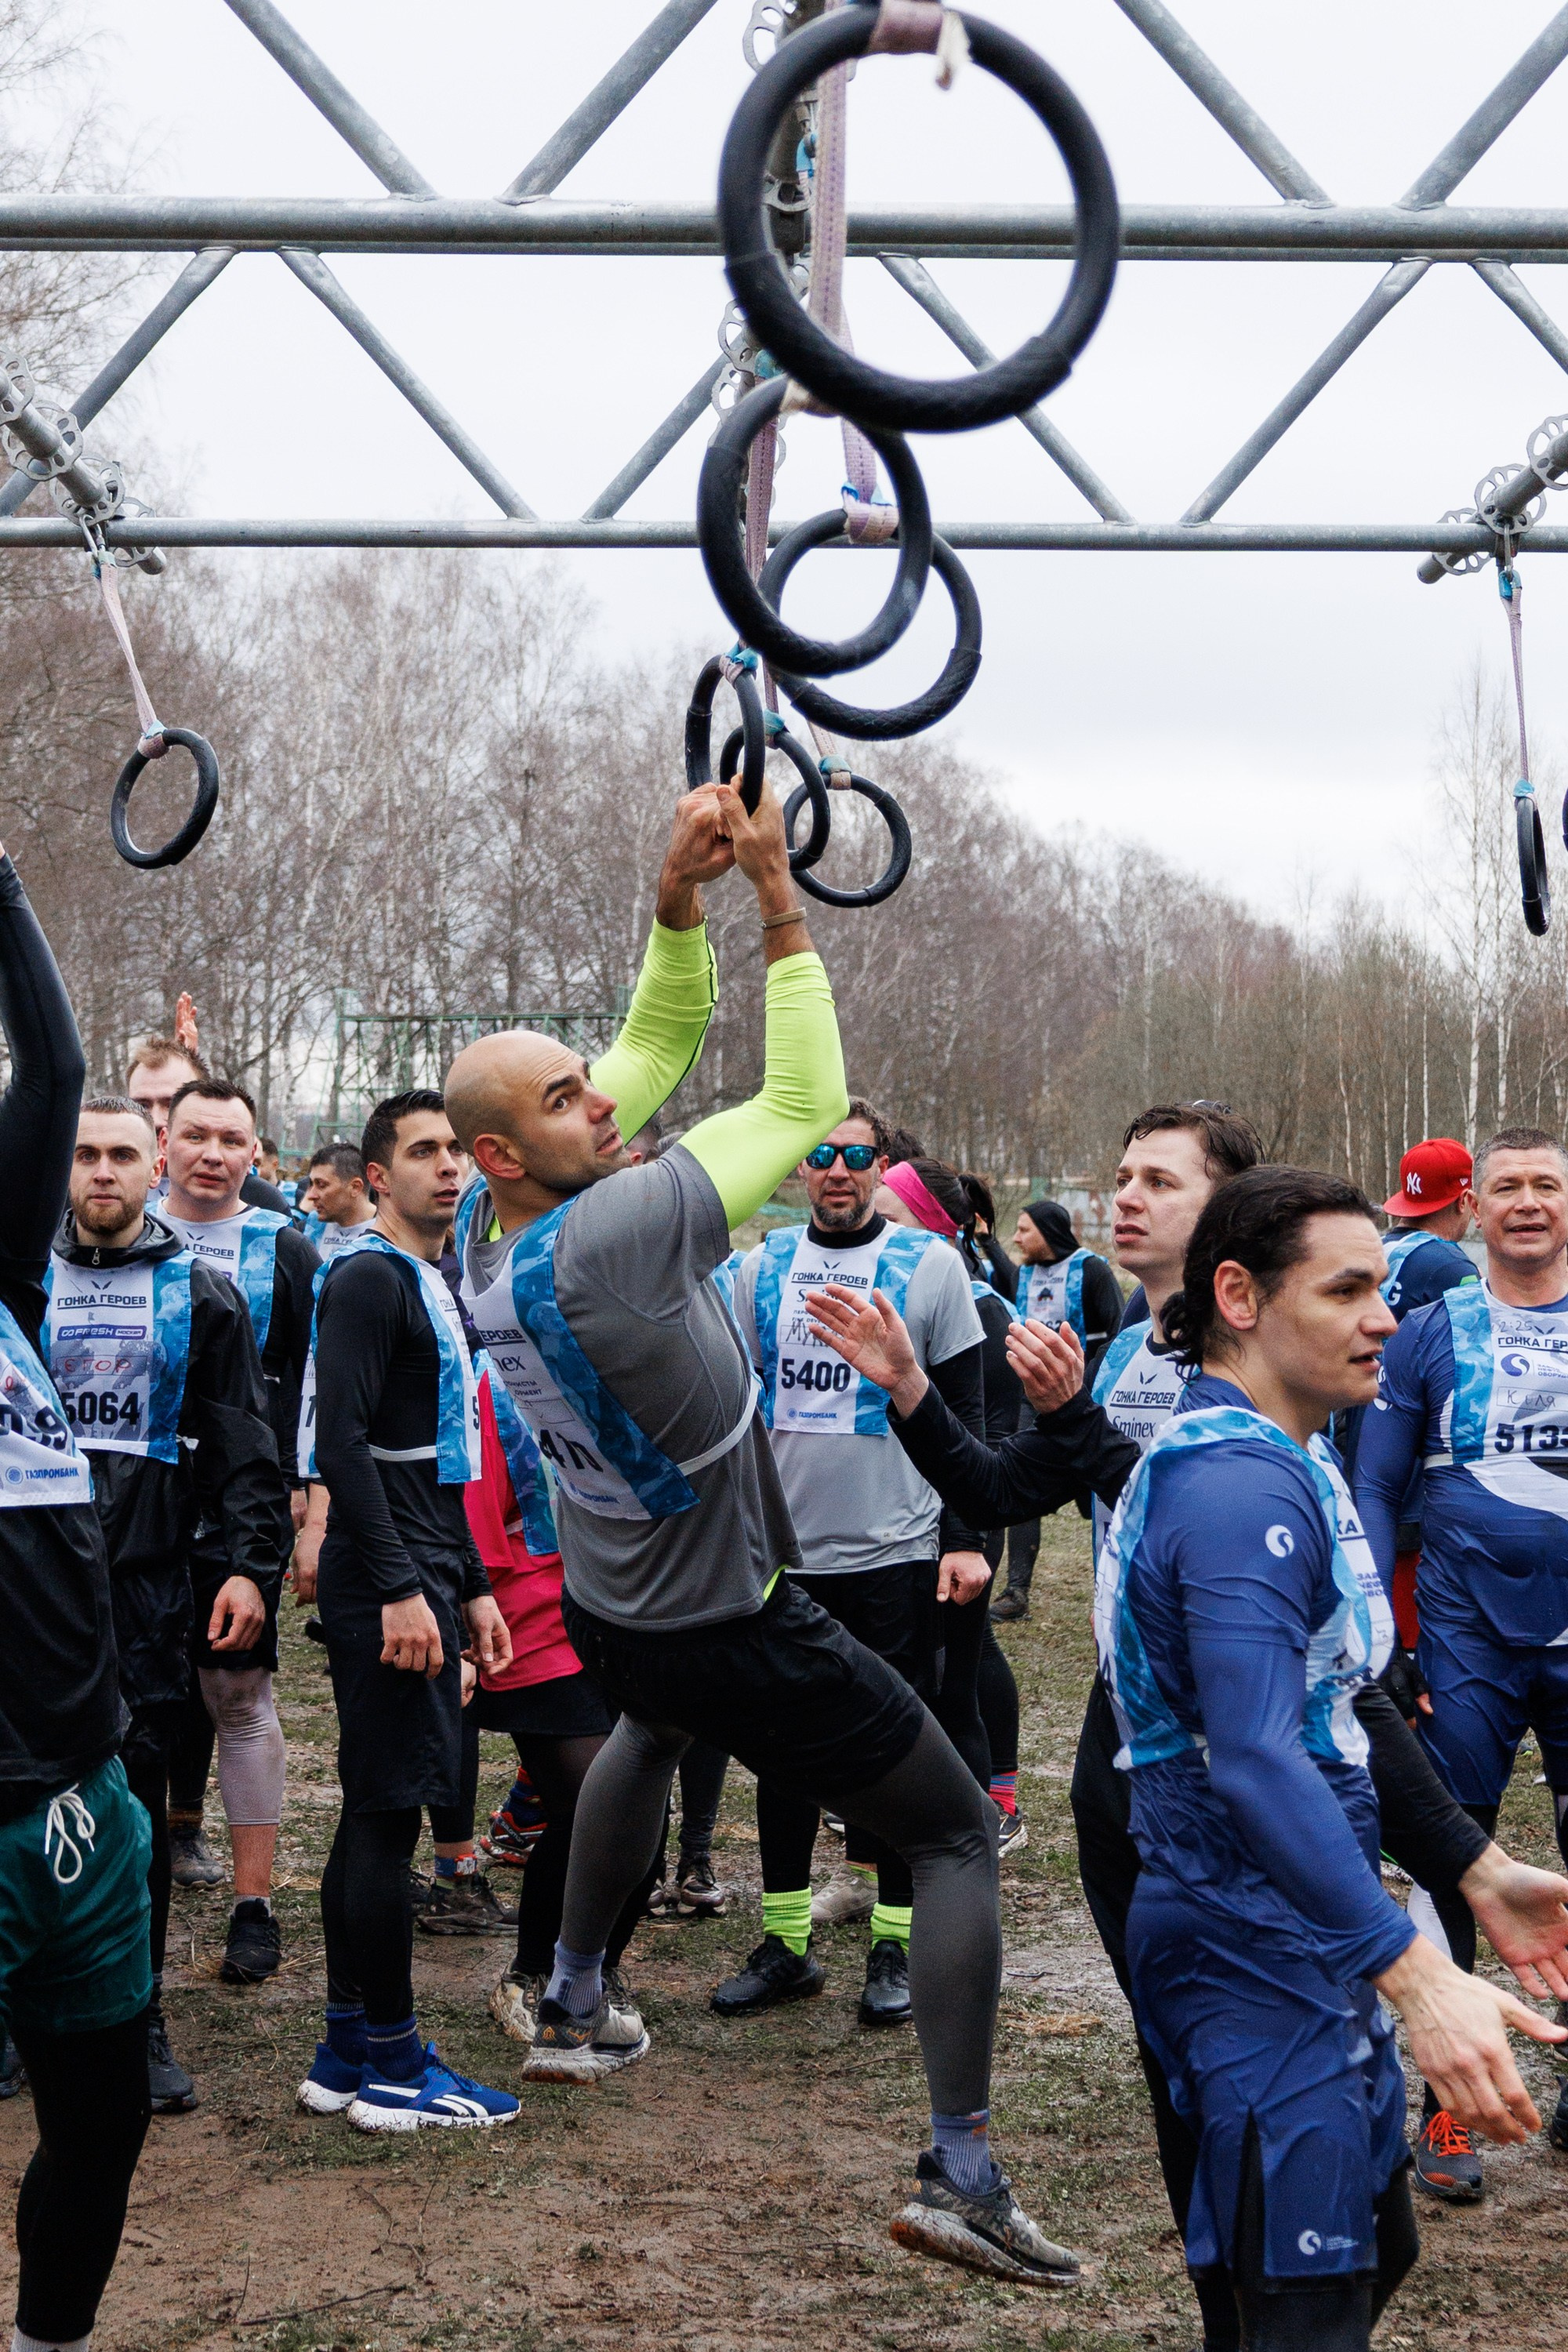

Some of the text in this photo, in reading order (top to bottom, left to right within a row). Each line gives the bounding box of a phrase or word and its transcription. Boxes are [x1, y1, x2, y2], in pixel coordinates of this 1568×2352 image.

[193, 1243, 234, 1257] ГЕРОЕВ
[792, 1272, 868, 1285] ГОНКА ГЕРОЕВ
[57, 1294, 147, 1306] ГОНКА ГЕРОЕВ
[1497, 1337, 1541, 1347] ГОНКА
[782, 1358, 851, 1392] 5400
[1112, 1390, 1176, 1404] ГОНКА ГЕРОЕВ
[62, 1391, 140, 1425] 5064
[25, 1467, 79, 1479] ГАЗПРОМБАНК
